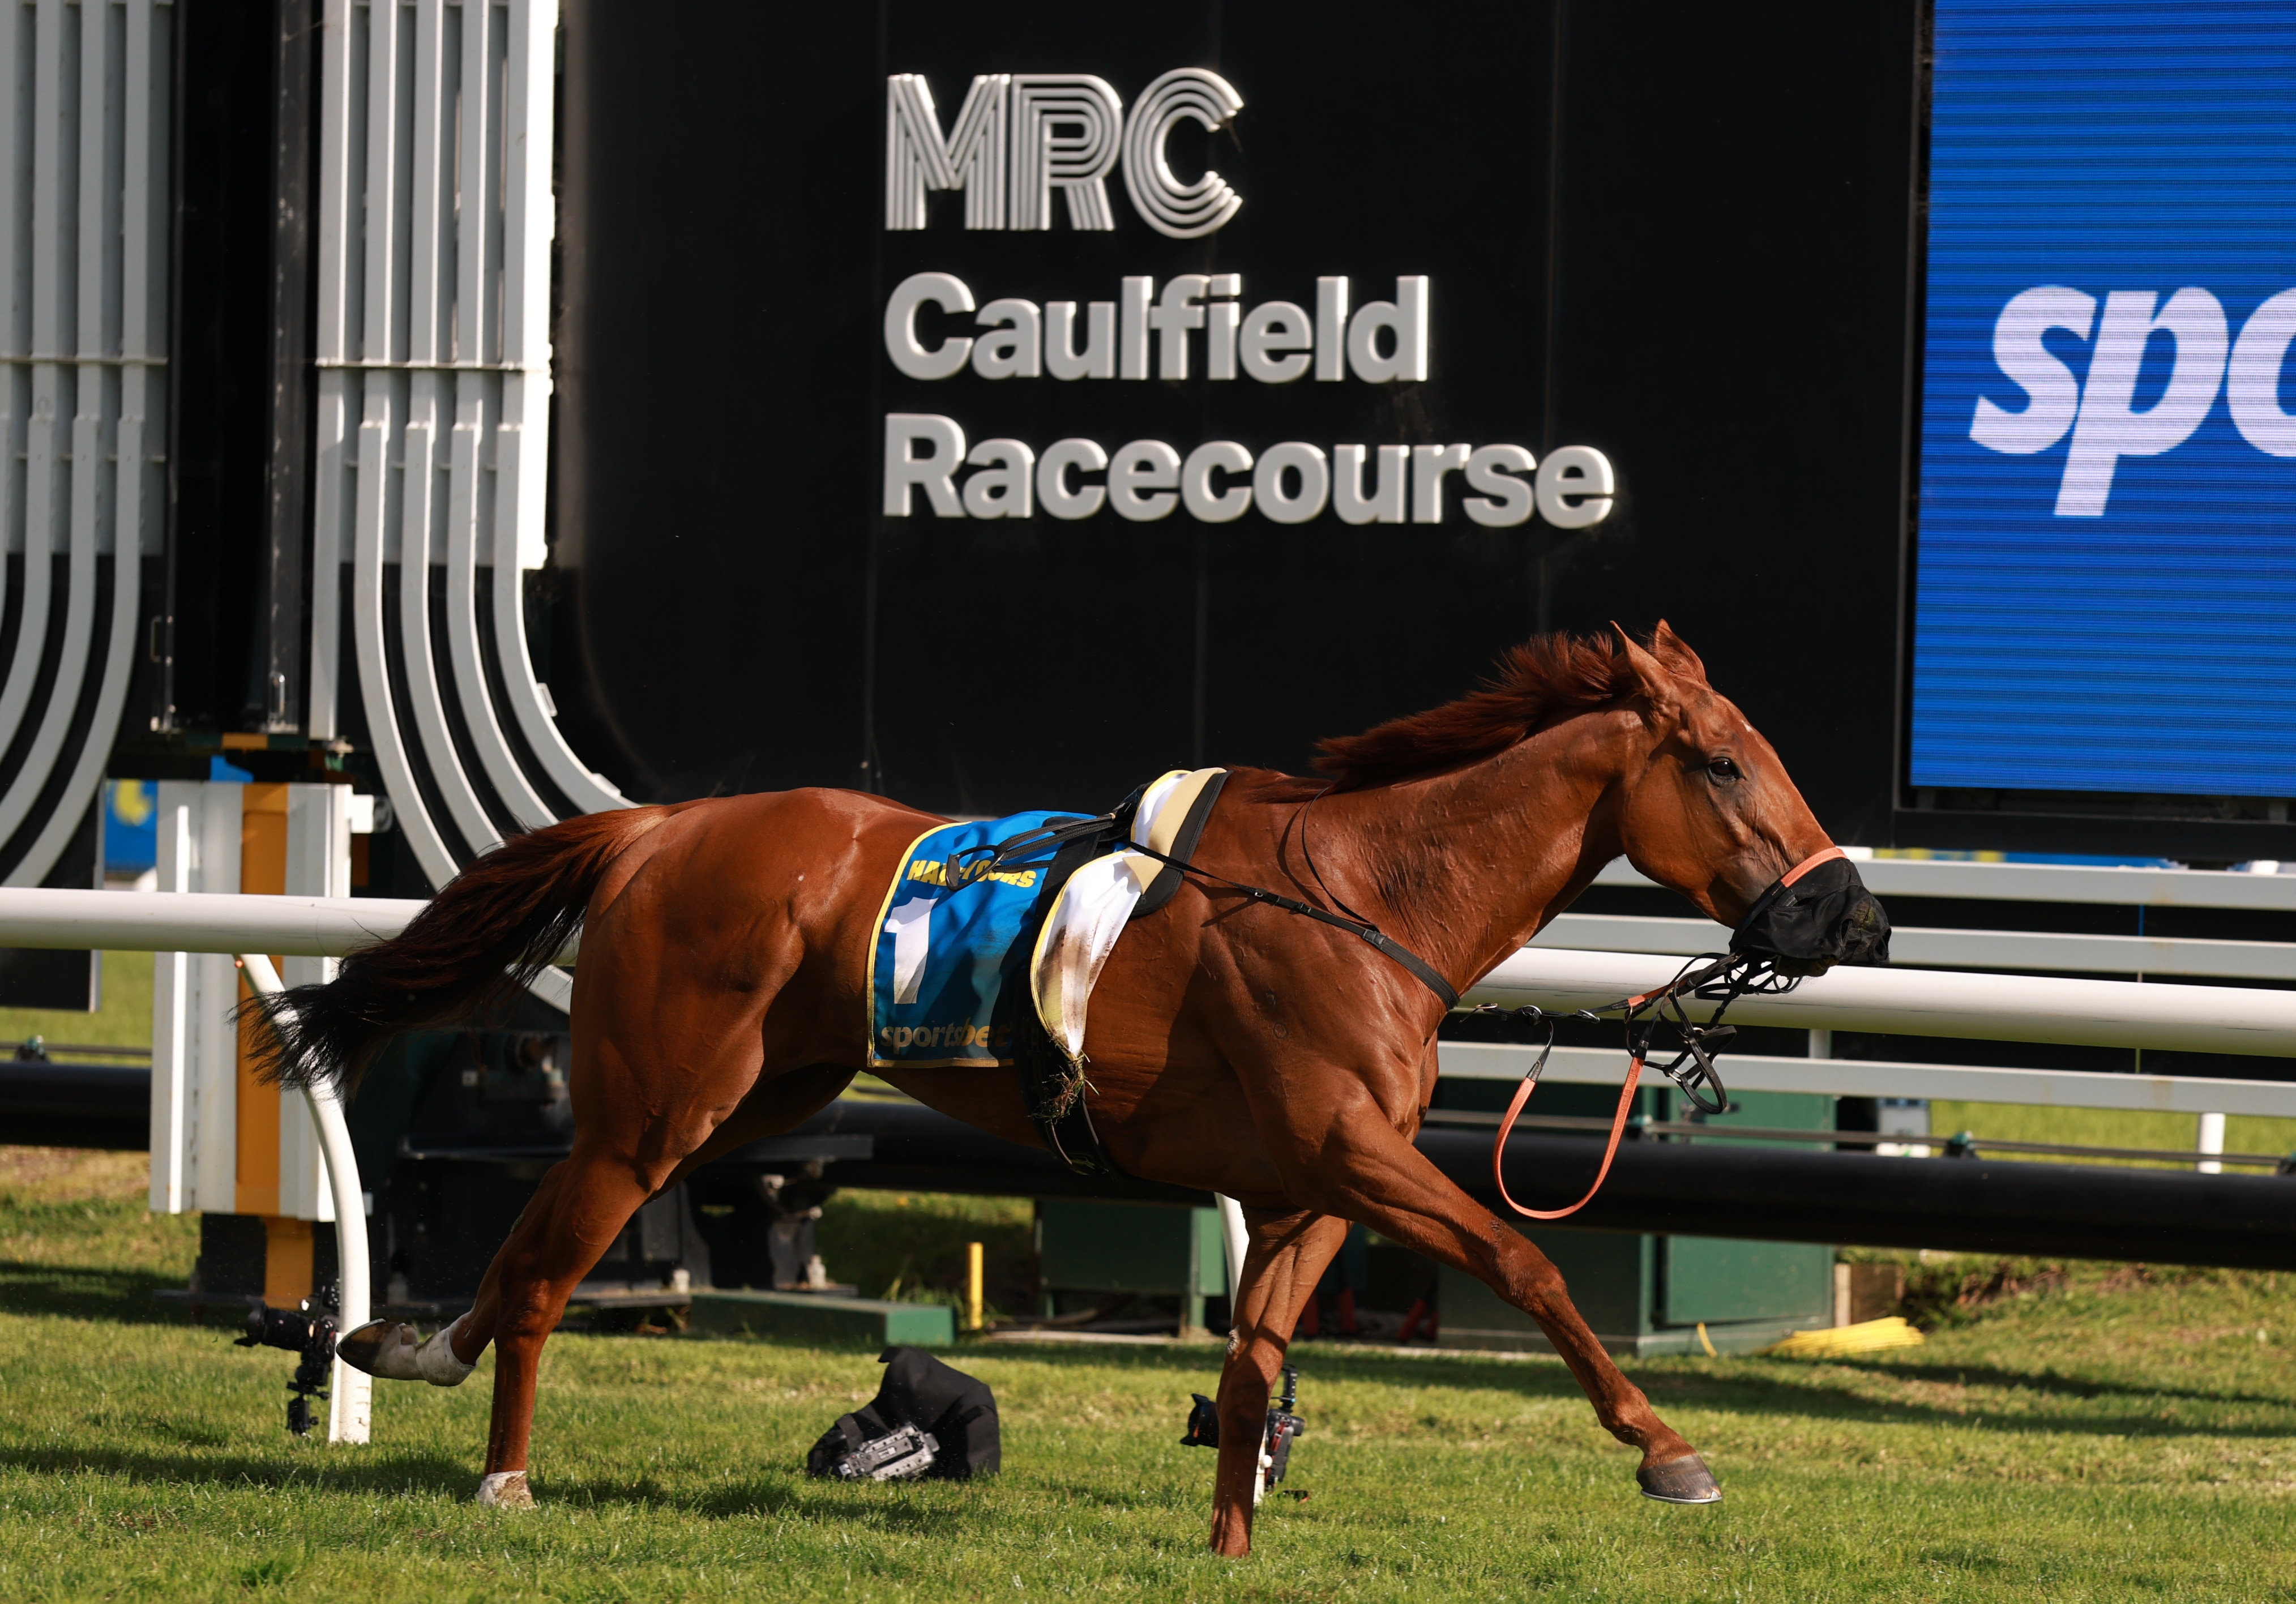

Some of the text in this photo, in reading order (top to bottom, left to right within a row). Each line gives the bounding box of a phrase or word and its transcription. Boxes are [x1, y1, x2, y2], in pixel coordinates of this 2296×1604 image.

[885, 67, 1245, 239] MRC
[884, 271, 1429, 383] Caulfield
[883, 412, 1615, 529] Racecourse
[884, 896, 939, 1004] 1
[880, 1017, 1011, 1055] sportsbet
